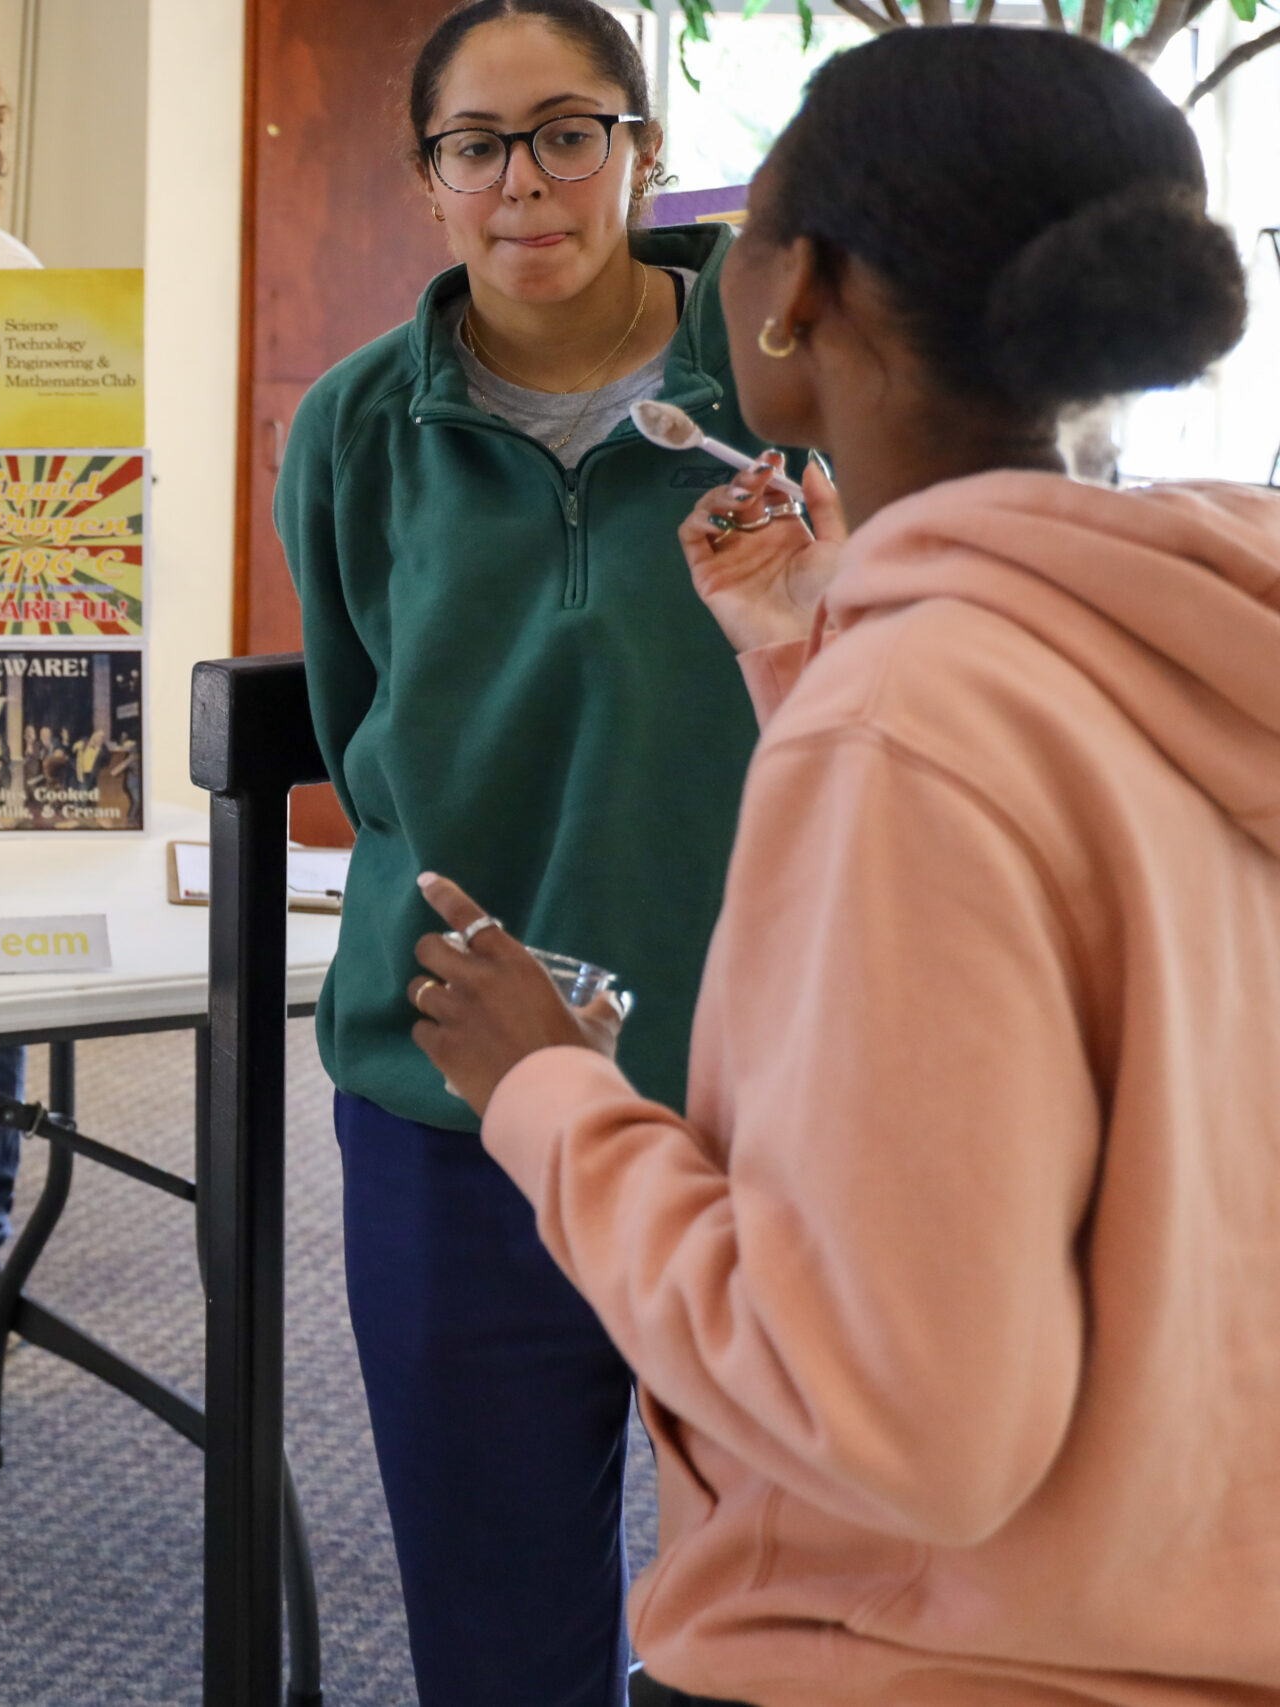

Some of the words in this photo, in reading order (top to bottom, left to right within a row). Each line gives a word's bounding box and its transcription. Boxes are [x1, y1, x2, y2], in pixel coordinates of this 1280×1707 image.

[4, 319, 59, 332] Science
[5, 336, 86, 352] Technology
[6, 355, 94, 371] Engineering
[96, 356, 110, 369] &
[4, 374, 100, 388] Mathematics
[101, 374, 136, 387] Club
[34, 786, 101, 802] Cooked
[41, 804, 55, 819] &
[62, 804, 121, 820] Cream
